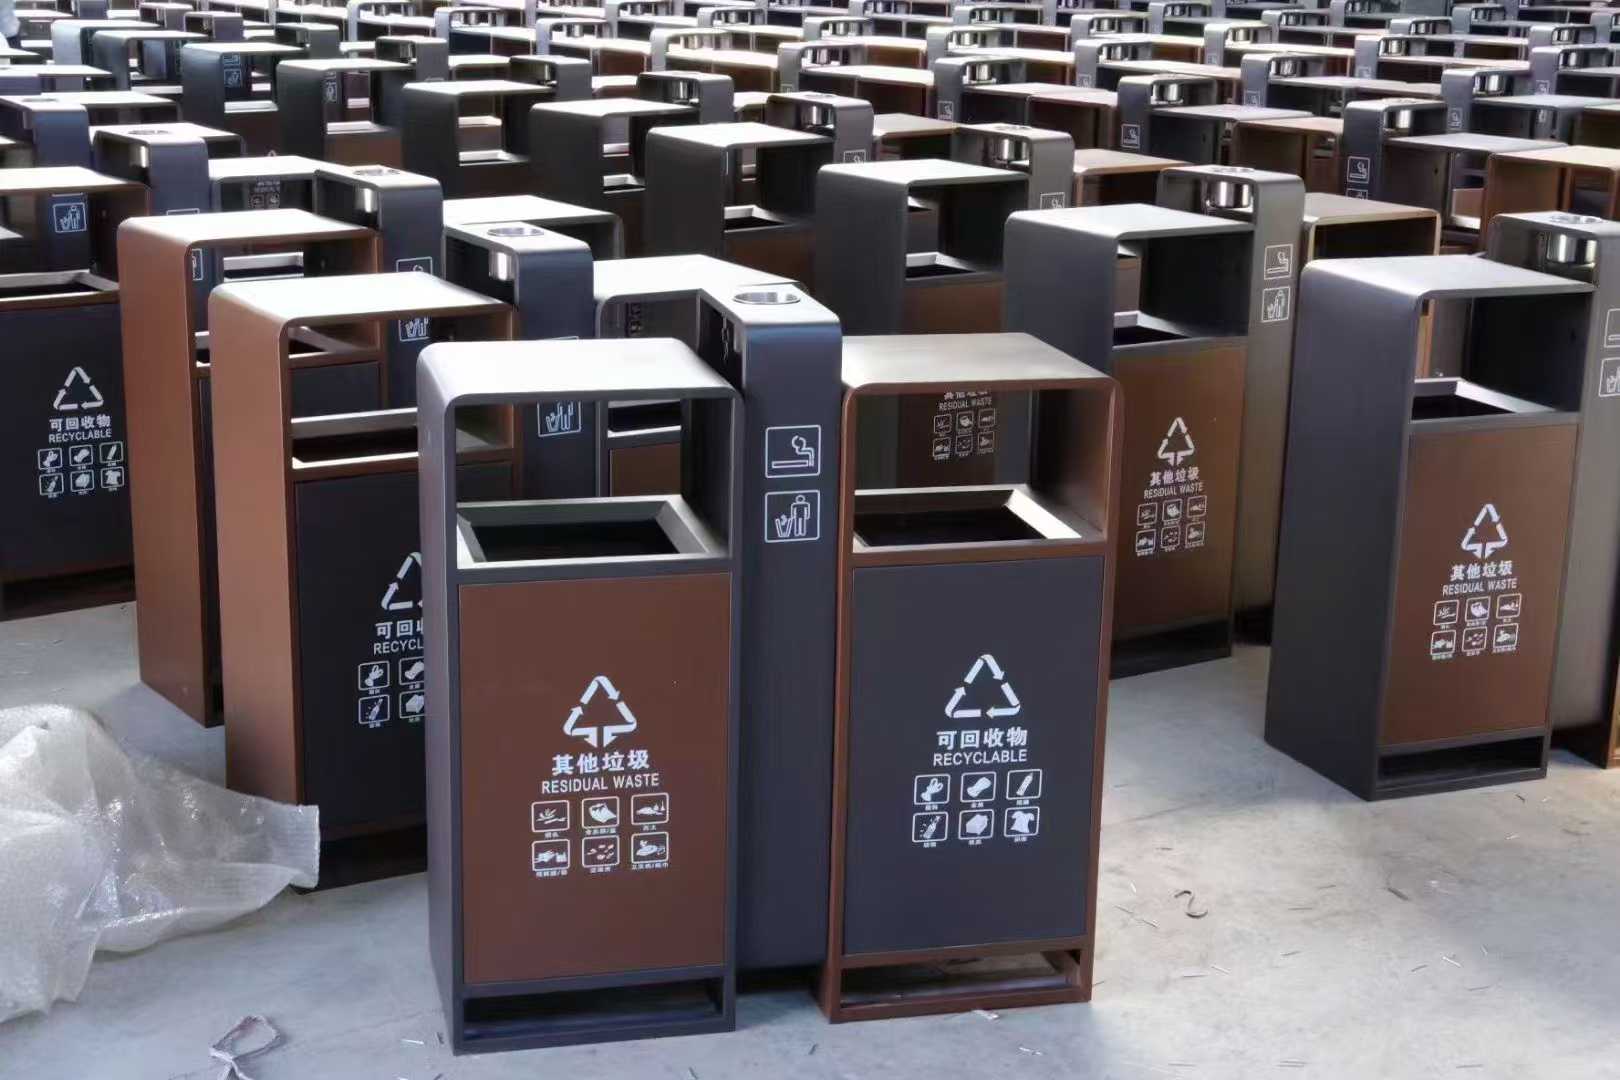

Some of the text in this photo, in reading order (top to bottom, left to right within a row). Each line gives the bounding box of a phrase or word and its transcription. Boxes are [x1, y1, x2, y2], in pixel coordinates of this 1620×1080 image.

[49, 414, 111, 431] 可回收物
[48, 429, 112, 443] RECYCLABLE
[1150, 466, 1200, 486] 其他垃圾
[1143, 482, 1204, 499] RESIDUAL WASTE
[1450, 560, 1512, 582] 其他垃圾
[1442, 578, 1518, 596] RESIDUAL WASTE
[936, 726, 1028, 751] 可回收物
[552, 750, 651, 777] 其他垃圾
[933, 749, 1028, 767] RECYCLABLE
[541, 772, 660, 795] RESIDUAL WASTE
